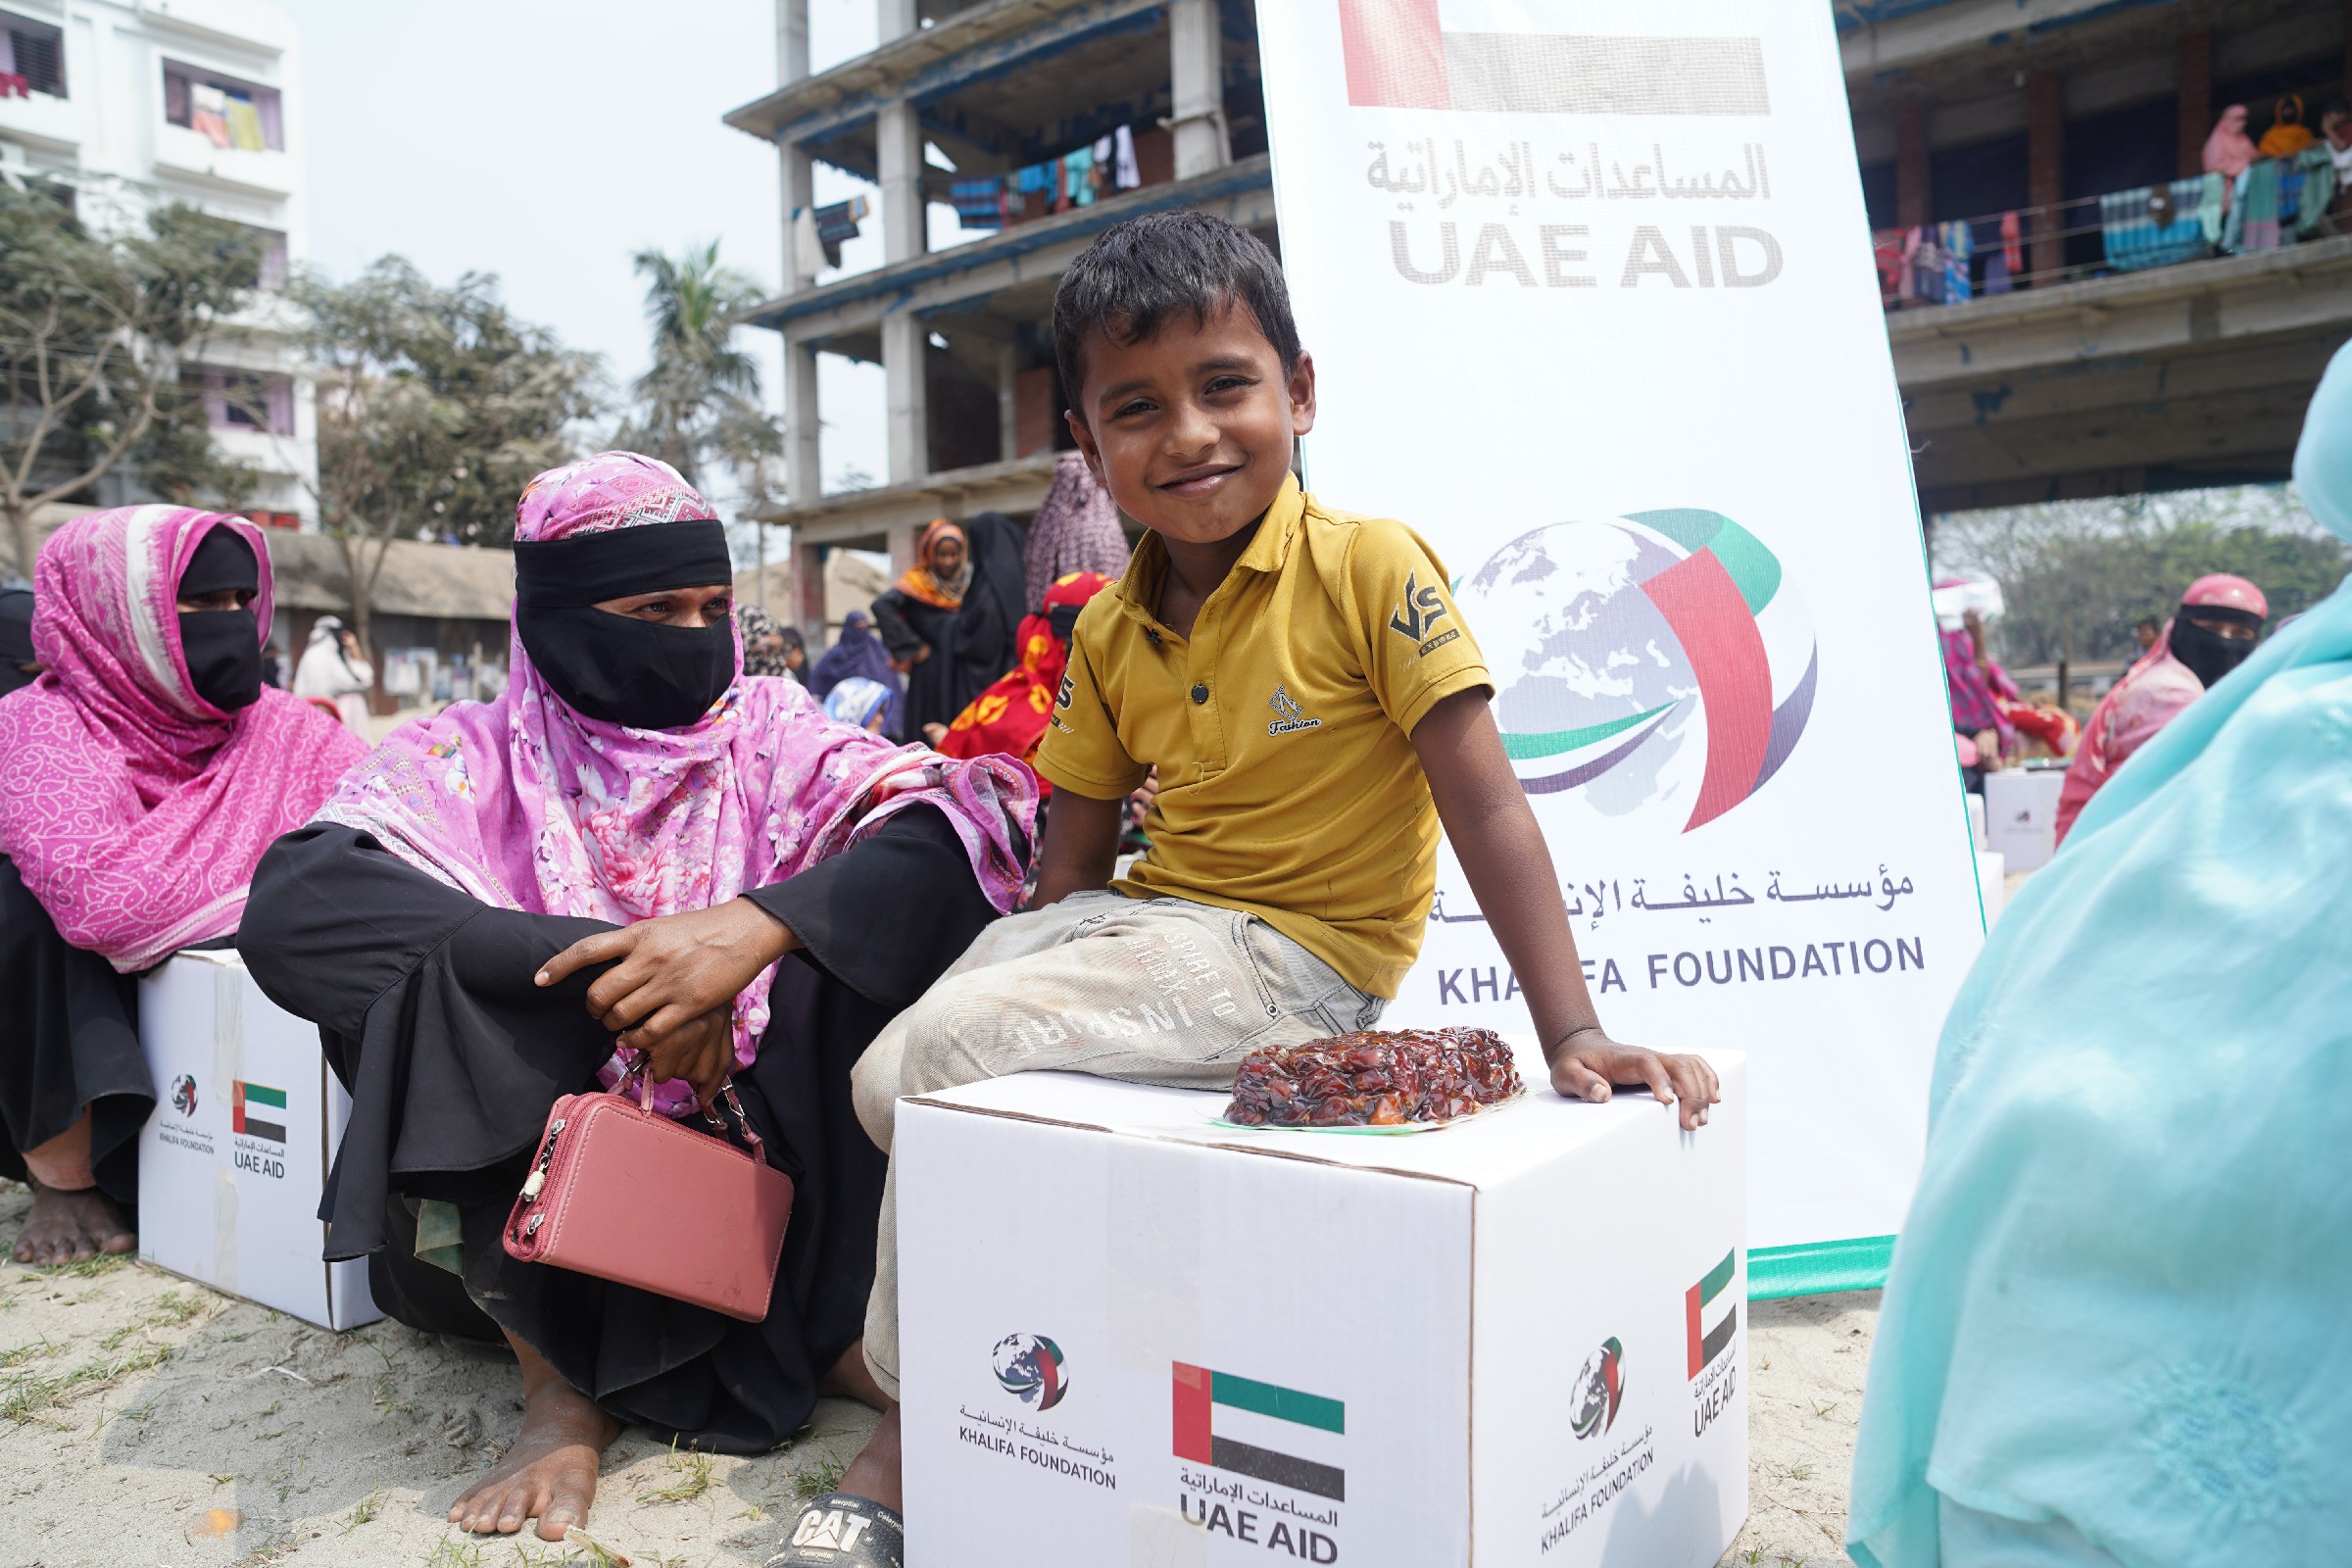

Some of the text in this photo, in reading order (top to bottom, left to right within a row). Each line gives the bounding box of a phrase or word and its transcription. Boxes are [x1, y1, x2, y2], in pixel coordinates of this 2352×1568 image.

[1367, 137, 1771, 216] المساعدات الإماراتية
[1389, 220, 1784, 288] UAE AID
[1268, 718, 1322, 736] Fashion
[1631, 873, 1754, 923] خليفة
[1767, 863, 1914, 911] مؤسسة
[1647, 936, 1925, 989] FOUNDATION
[234, 1151, 284, 1179] UAE AID
[1694, 1365, 1737, 1438] UAE AID
[959, 1404, 1114, 1464] مؤسسة خليفة الإنسانية
[959, 1426, 1116, 1490] KHALIFA FOUNDATION
[1180, 1467, 1338, 1527] المساعدات الإماراتية
[1541, 1446, 1653, 1555] KHALIFA FOUNDATION
[792, 1509, 872, 1553] CAT
[1180, 1493, 1339, 1565] UAE AID
